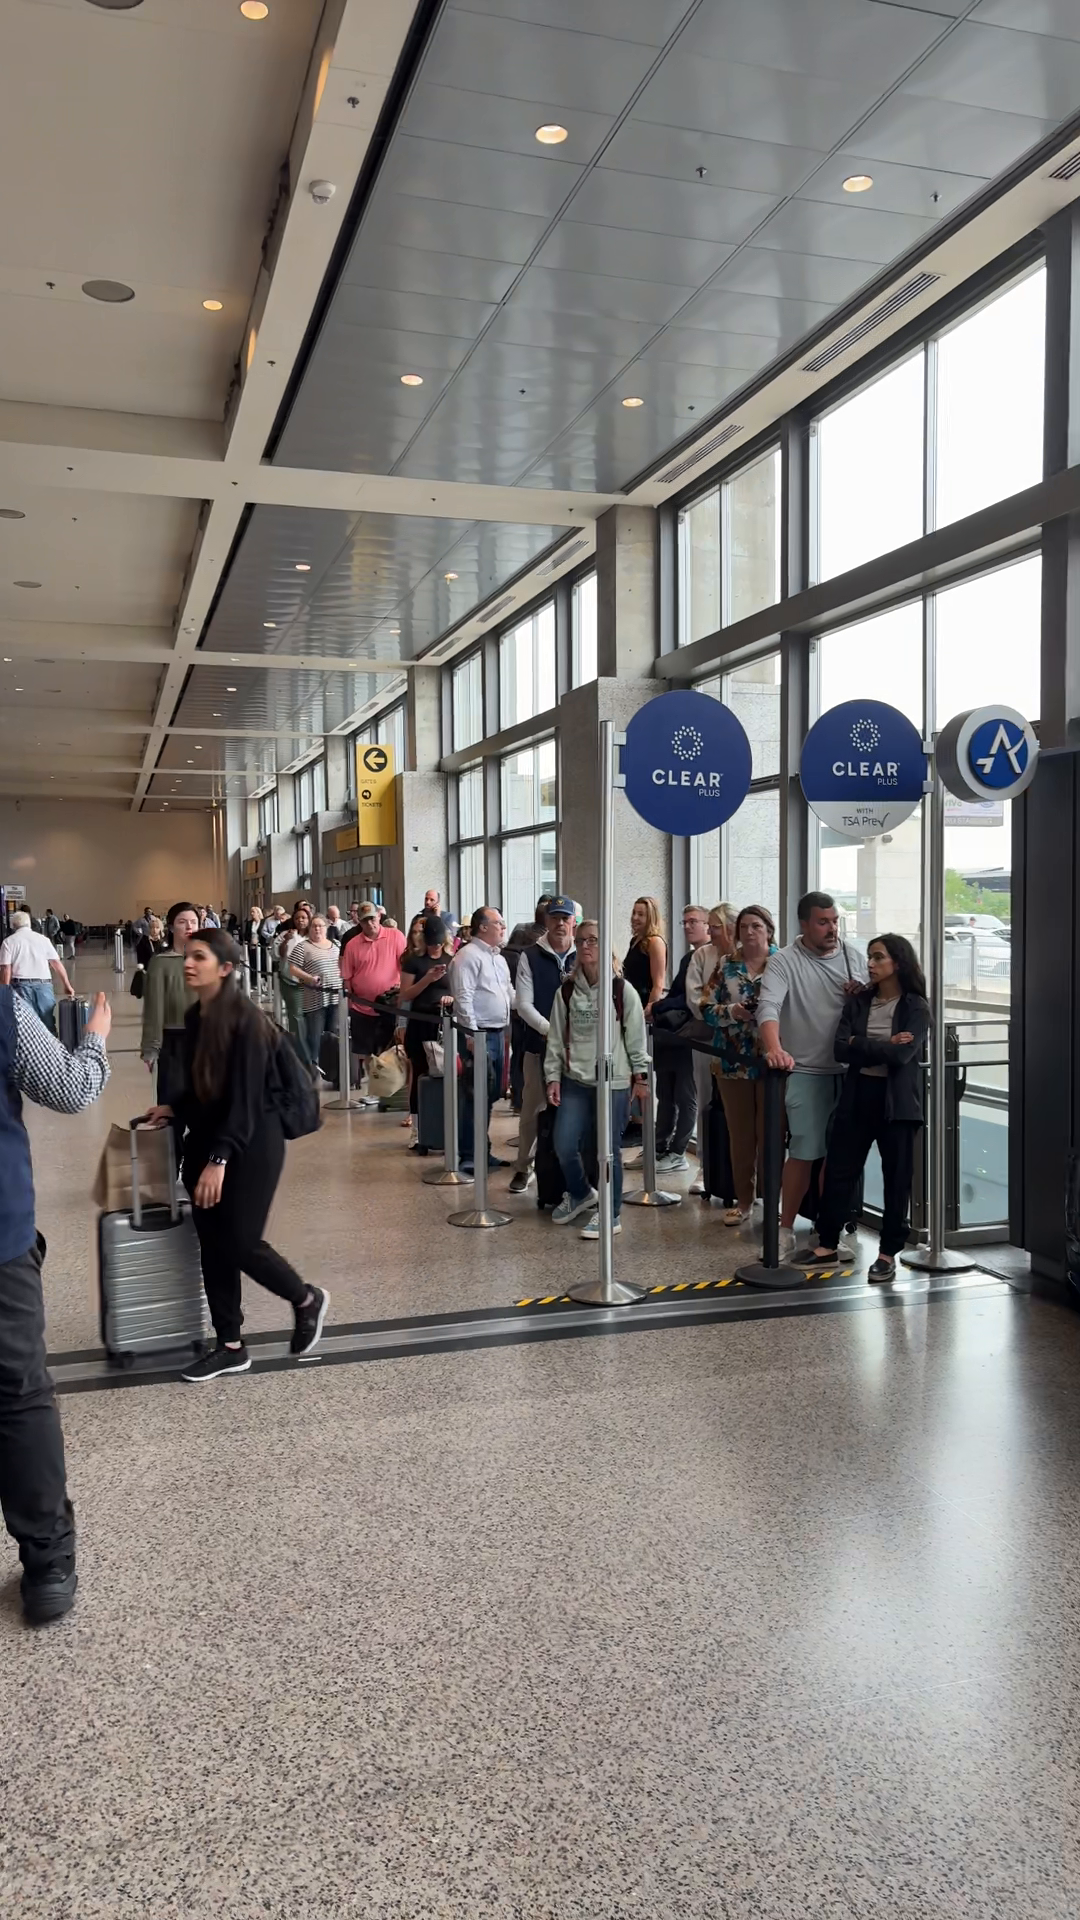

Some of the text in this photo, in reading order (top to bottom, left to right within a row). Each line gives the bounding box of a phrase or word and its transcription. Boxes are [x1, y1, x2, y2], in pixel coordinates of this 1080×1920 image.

[832, 761, 898, 776] CLEAR
[652, 769, 720, 787] CLEAR
[877, 778, 898, 786] PLUS
[698, 788, 720, 797] PLUS
[842, 816, 860, 826] TSA
